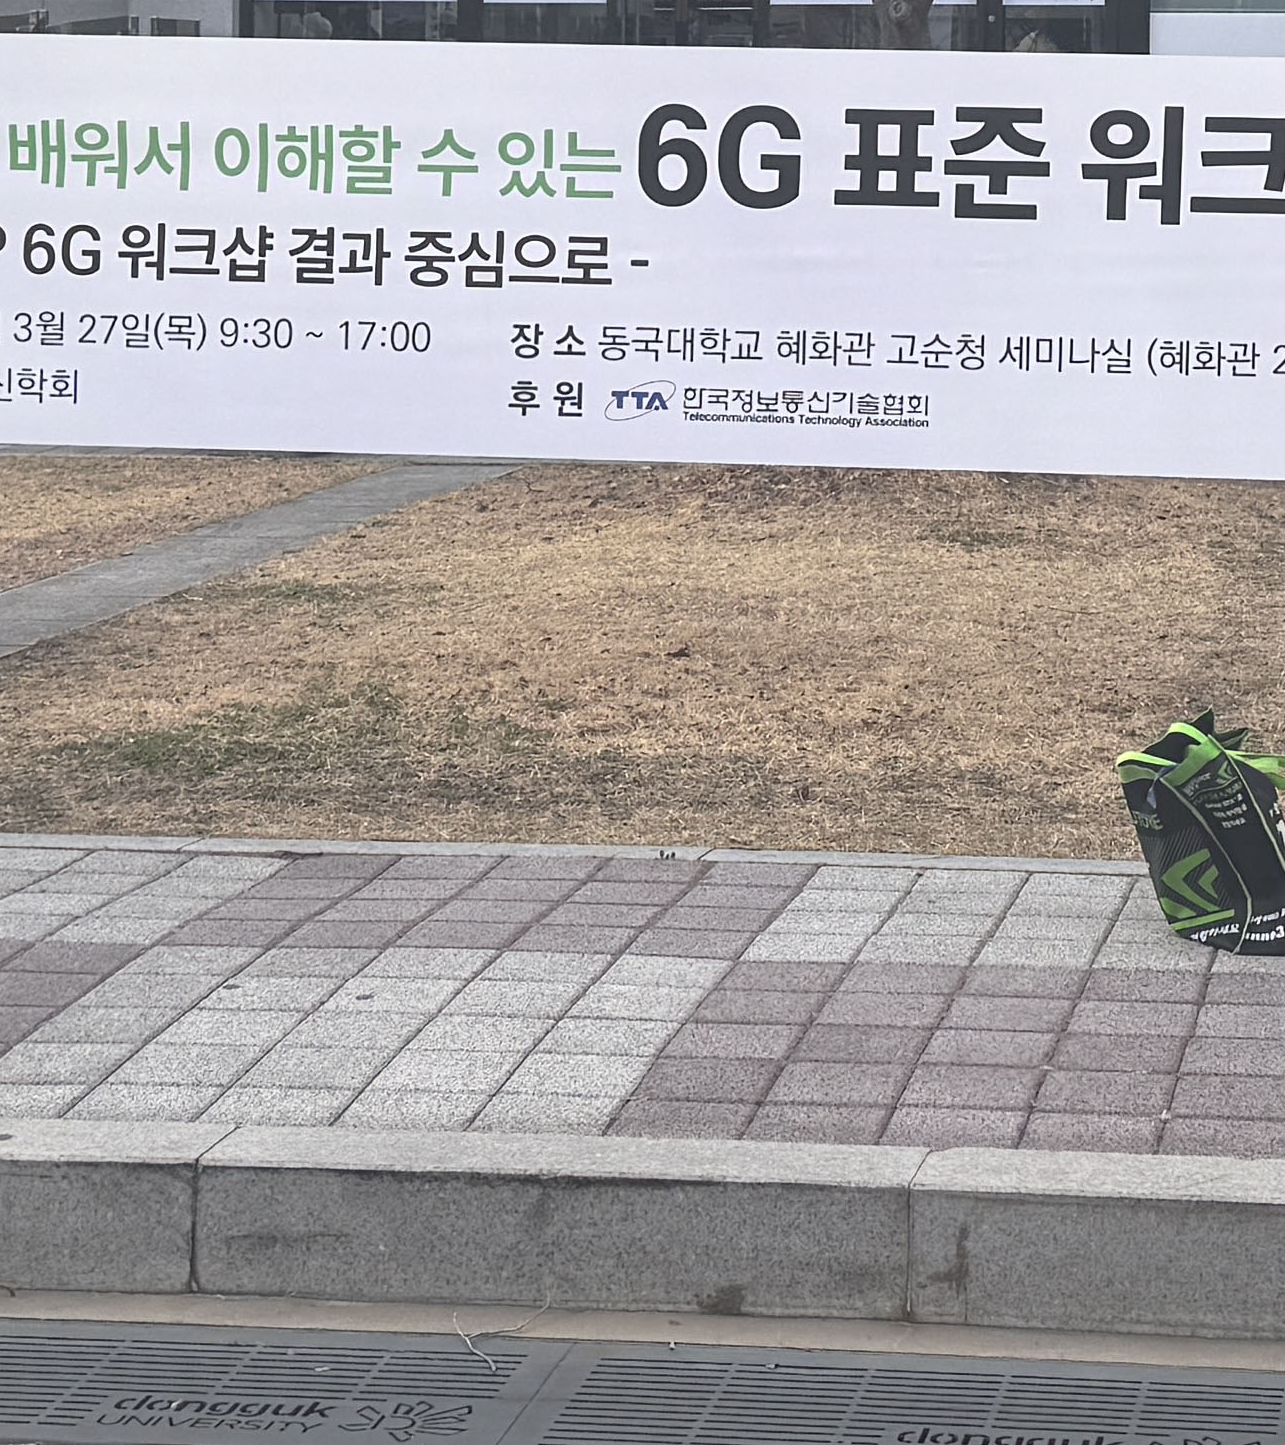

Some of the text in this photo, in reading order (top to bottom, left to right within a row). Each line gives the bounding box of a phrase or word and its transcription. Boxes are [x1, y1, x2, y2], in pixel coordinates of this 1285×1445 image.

[8, 118, 191, 192] 배워서
[214, 122, 402, 195] 이해할
[417, 128, 479, 197] 수
[498, 128, 622, 199] 있는
[638, 103, 802, 210] 6G
[833, 106, 1051, 221] 표준
[23, 223, 101, 276] 6G
[117, 222, 275, 283] 워크샵
[288, 226, 392, 286] 결과
[404, 230, 613, 289] 중심으로
[13, 311, 64, 346] 3월
[78, 312, 207, 351] 27일(목)
[220, 317, 293, 349] 9:30
[339, 320, 431, 353] 17:00
[598, 326, 763, 364] 동국대학교
[776, 329, 876, 367] 혜화관
[886, 333, 985, 371] 고순청
[998, 336, 1132, 374] 세미나실
[1147, 337, 1261, 377] (혜화관
[610, 389, 669, 411] TTA
[683, 387, 929, 416] 한국정보통신기술협회
[683, 411, 930, 428] Telecommunications Technology Association
[113, 1394, 338, 1418] dongguk
